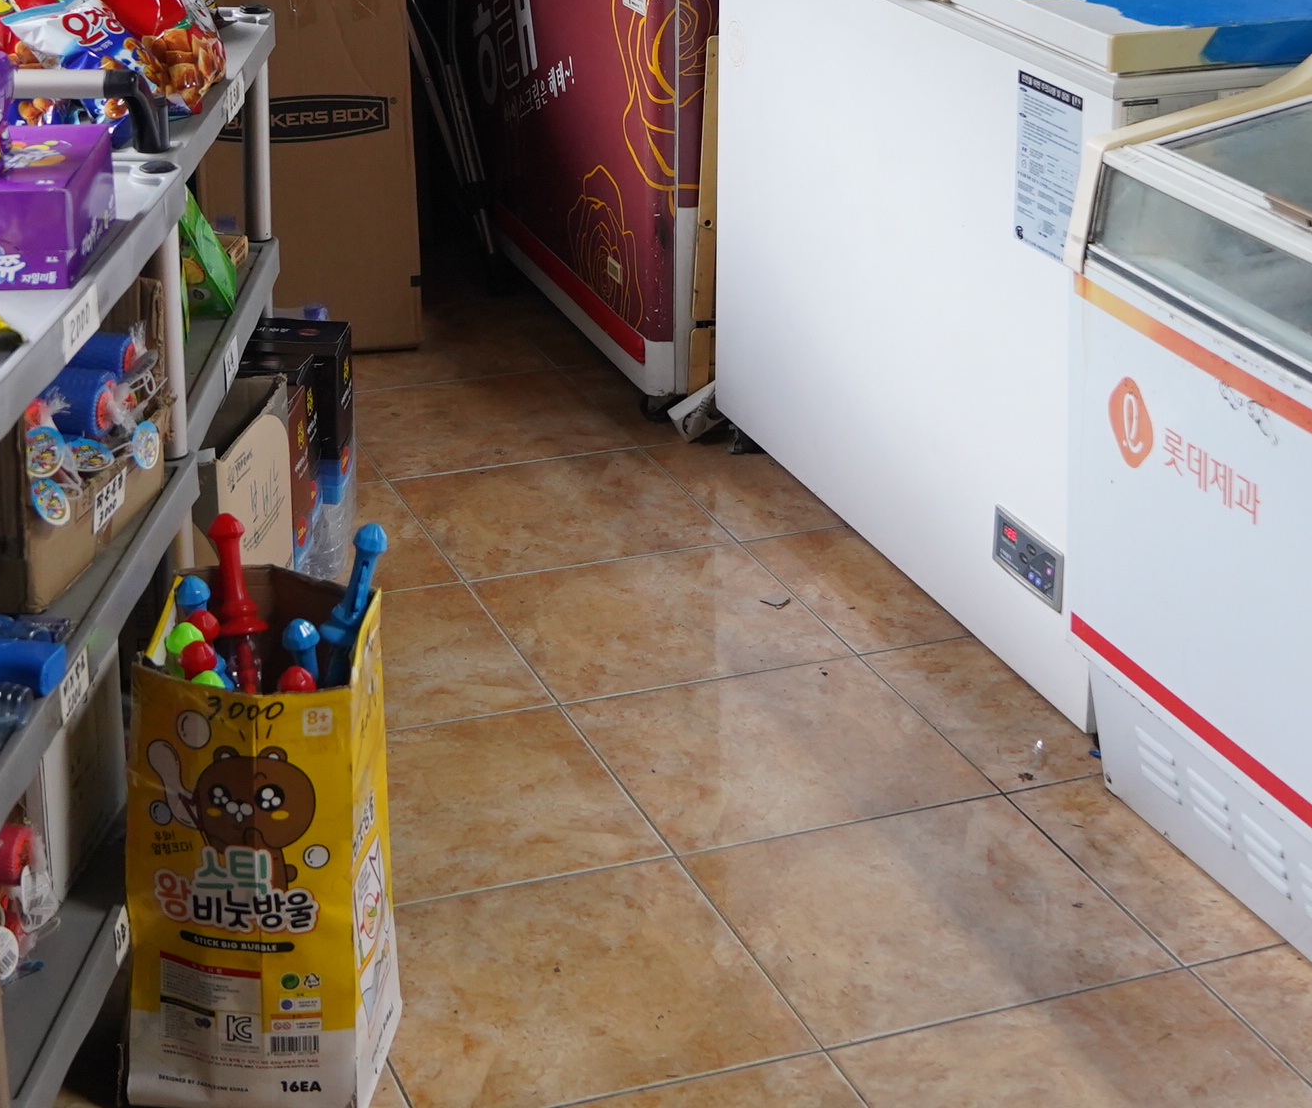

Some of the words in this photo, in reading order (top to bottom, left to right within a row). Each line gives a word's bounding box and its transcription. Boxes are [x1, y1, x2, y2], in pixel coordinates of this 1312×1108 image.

[332, 106, 380, 123] BOX
[20, 269, 59, 285] 자일리톨
[1162, 426, 1261, 525] 롯데제과
[306, 709, 329, 725] 8+
[196, 847, 272, 896] 스틱
[155, 871, 190, 919] 왕
[192, 889, 318, 930] 비눗방울
[193, 935, 220, 947] STICK
[221, 939, 238, 949] BIG
[241, 942, 278, 952] BUBBLE
[281, 1080, 323, 1092] 16EA
